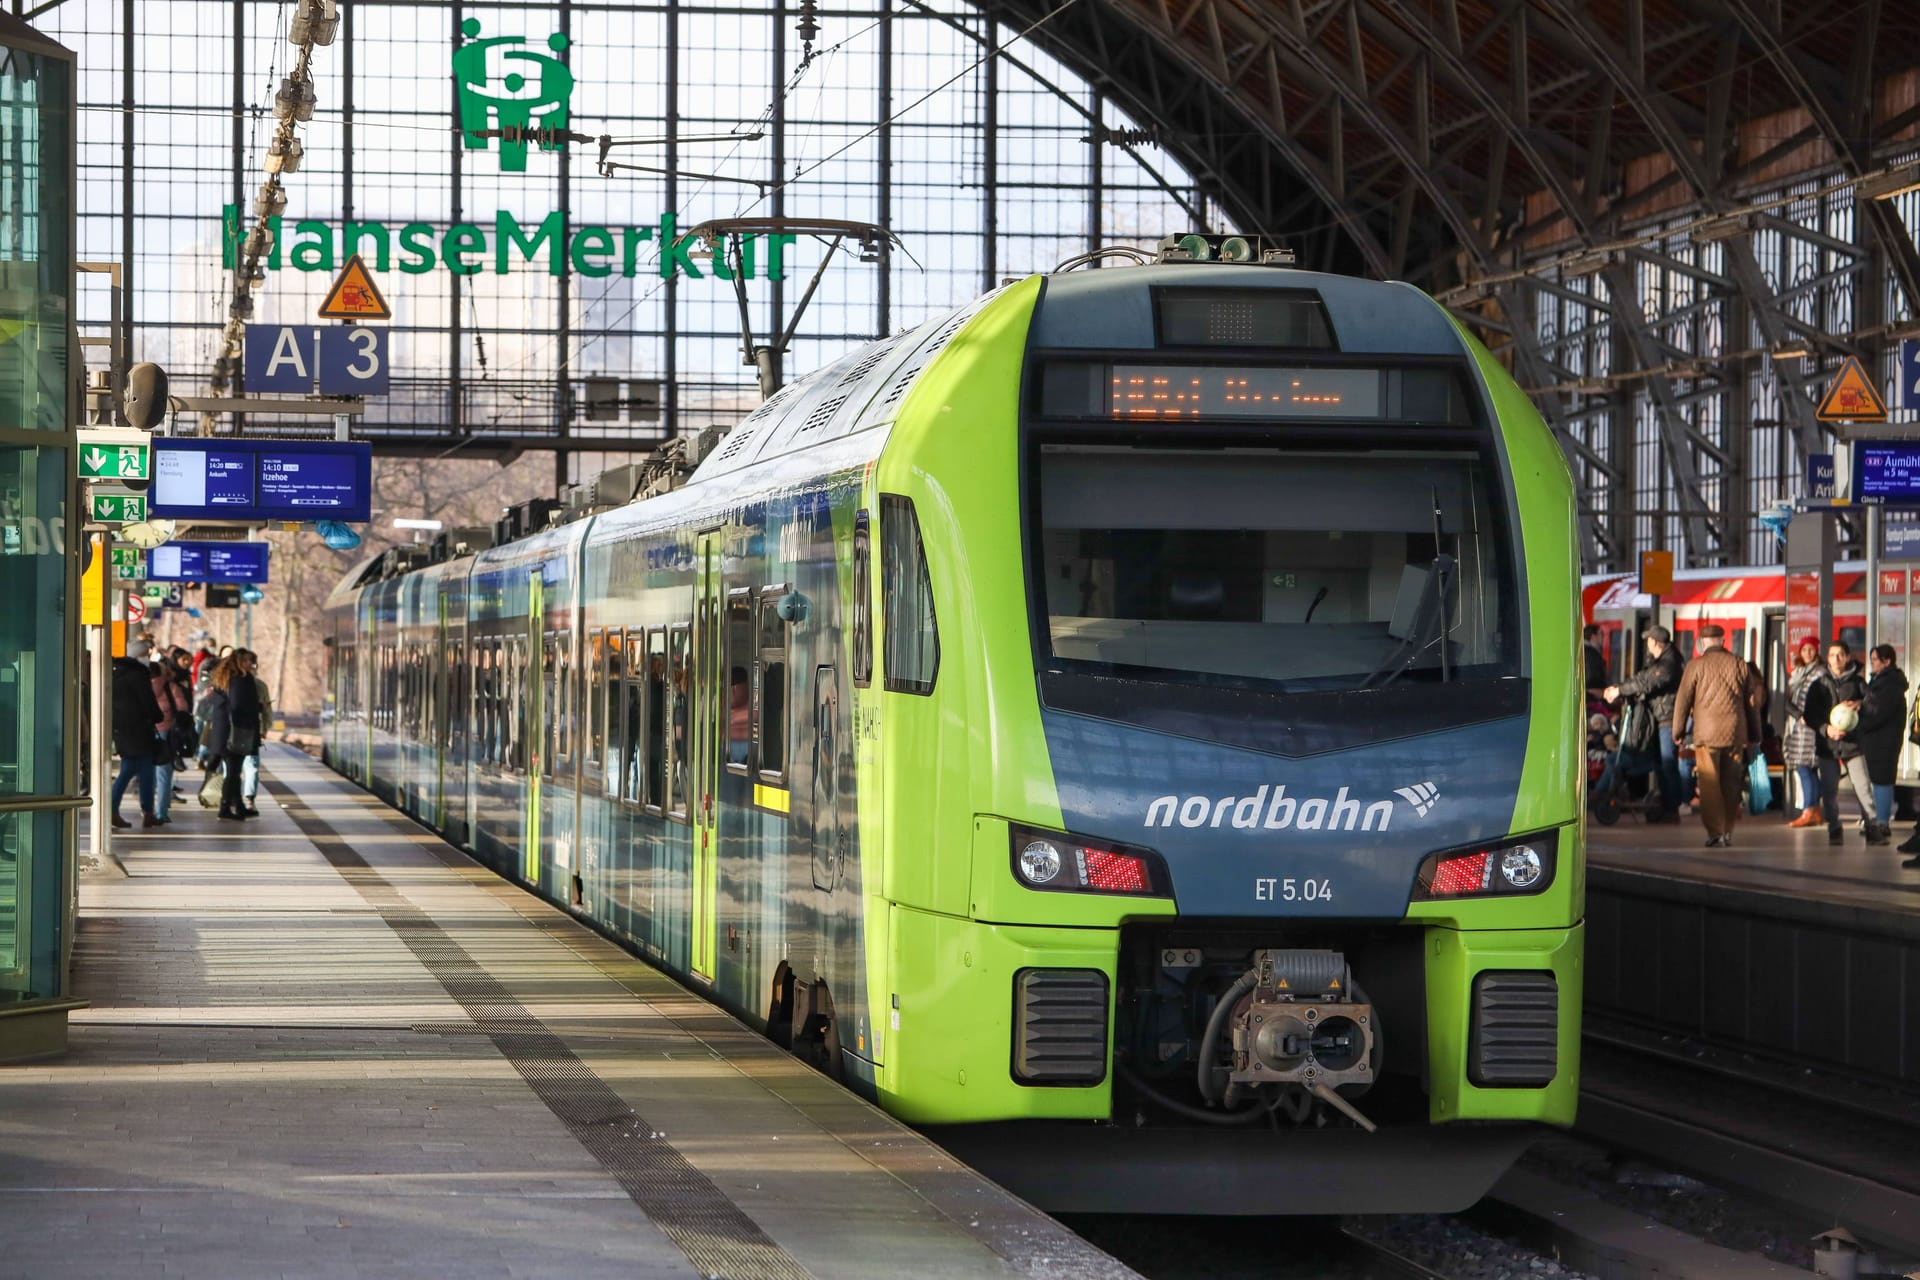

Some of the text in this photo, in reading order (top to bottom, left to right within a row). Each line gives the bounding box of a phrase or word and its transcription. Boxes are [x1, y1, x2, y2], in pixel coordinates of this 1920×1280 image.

[223, 204, 796, 281] HanseMerkur
[265, 328, 307, 377] A
[346, 328, 379, 379] 3
[262, 472, 289, 482] Itzehoe
[263, 463, 282, 472] 14:10
[1890, 467, 1896, 477] 5
[1861, 495, 1885, 504] Gleis 2
[169, 586, 182, 604] 3
[1143, 784, 1395, 832] nordbahn
[1255, 878, 1333, 902] ET 5.04
